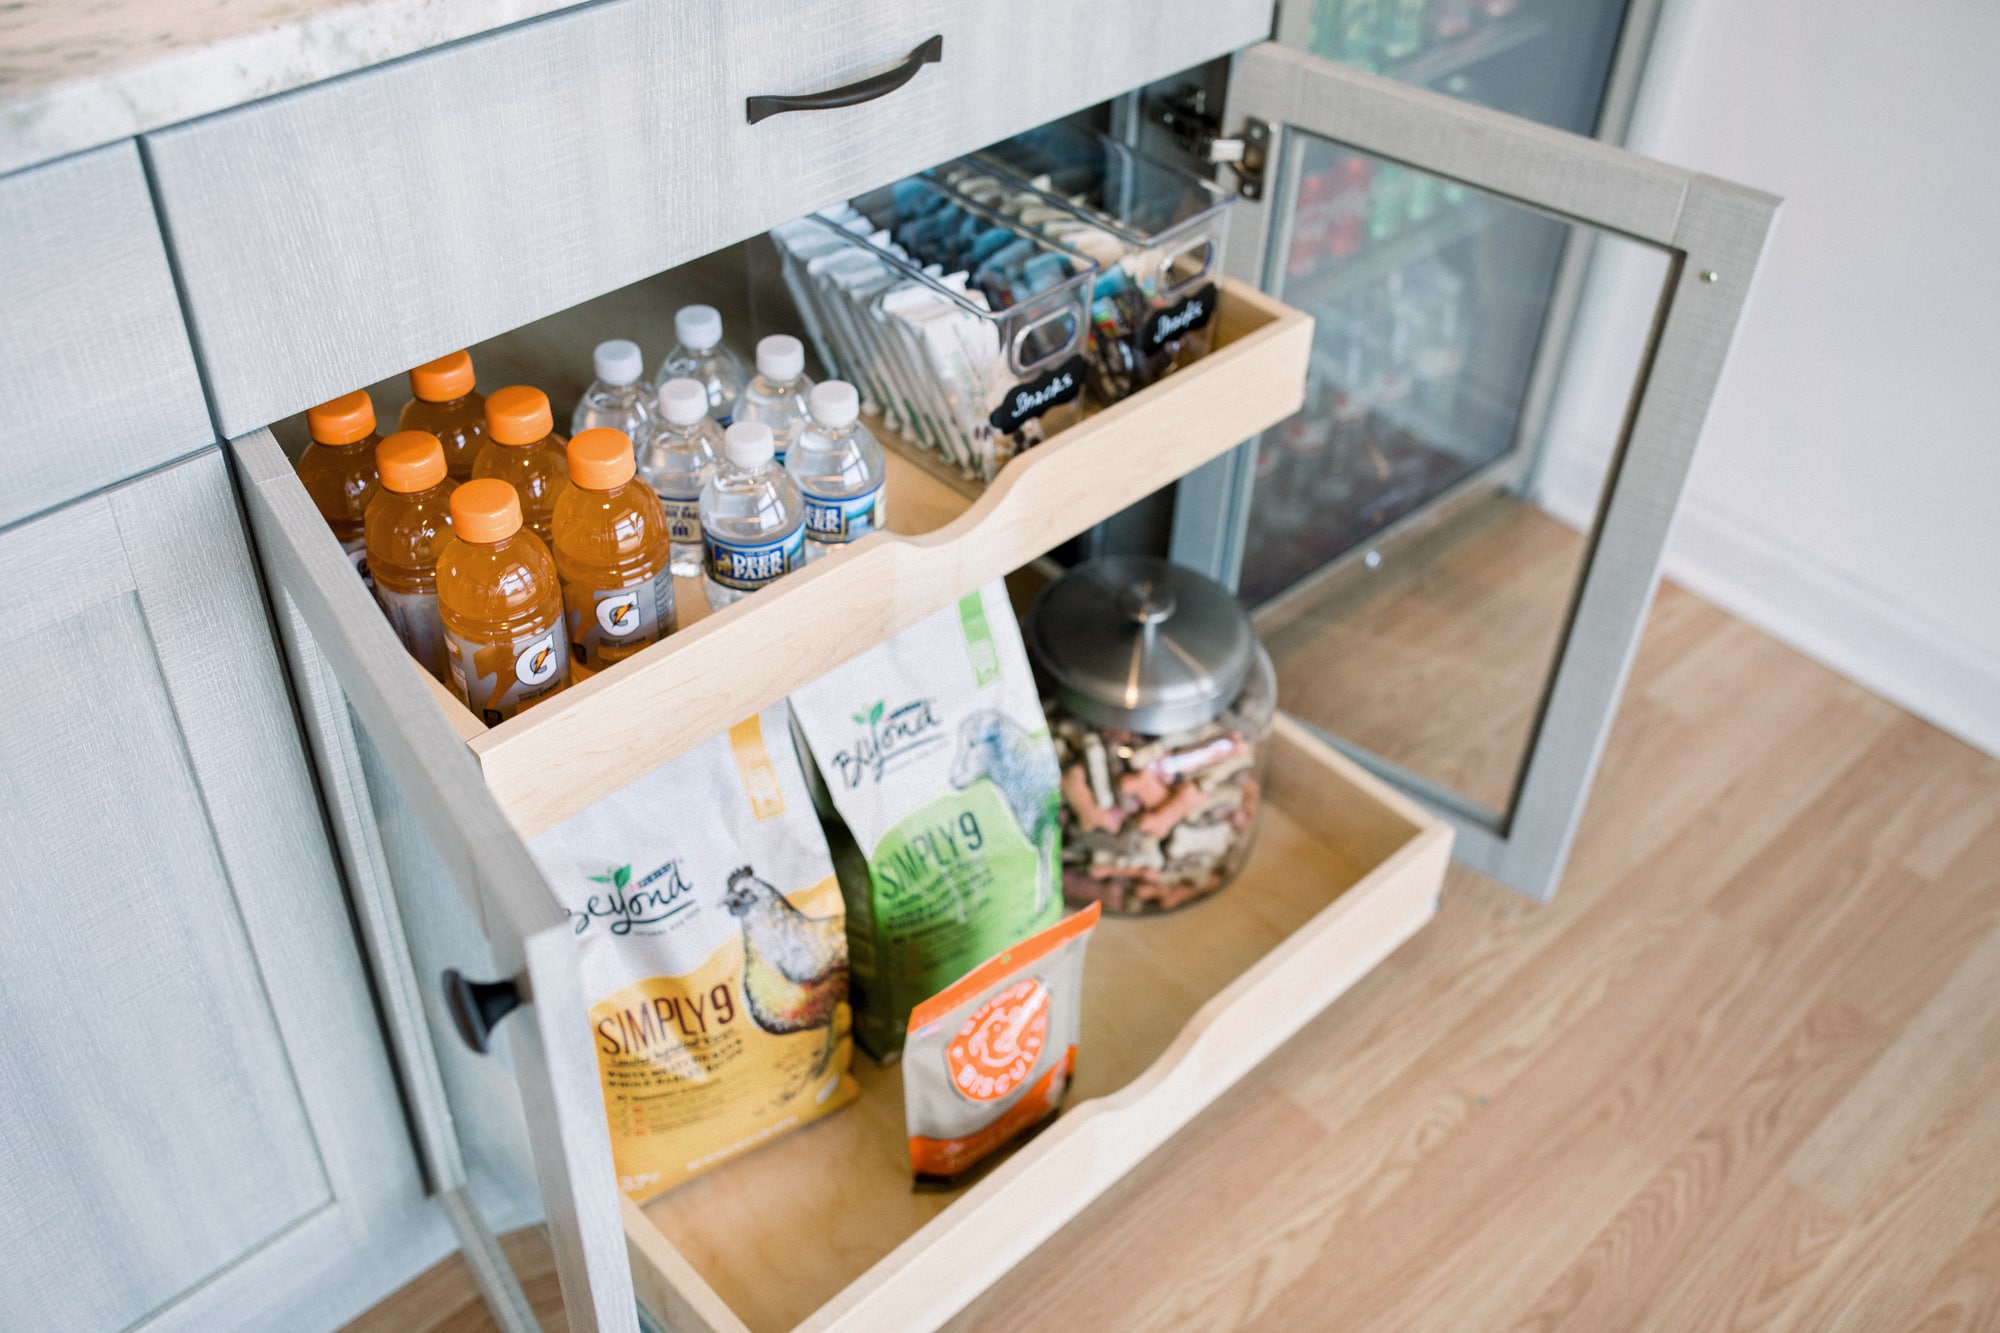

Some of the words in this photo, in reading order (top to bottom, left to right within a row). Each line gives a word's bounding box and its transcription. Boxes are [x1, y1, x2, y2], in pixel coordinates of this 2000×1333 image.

[1011, 372, 1073, 418] Snacks
[732, 550, 782, 567] DEER
[733, 562, 783, 580] PARK
[596, 591, 640, 637] G
[515, 632, 558, 686] G
[878, 819, 960, 900] SIMPLY
[959, 811, 983, 851] 9
[598, 994, 706, 1056] SIMPLY
[711, 984, 734, 1025] 9
